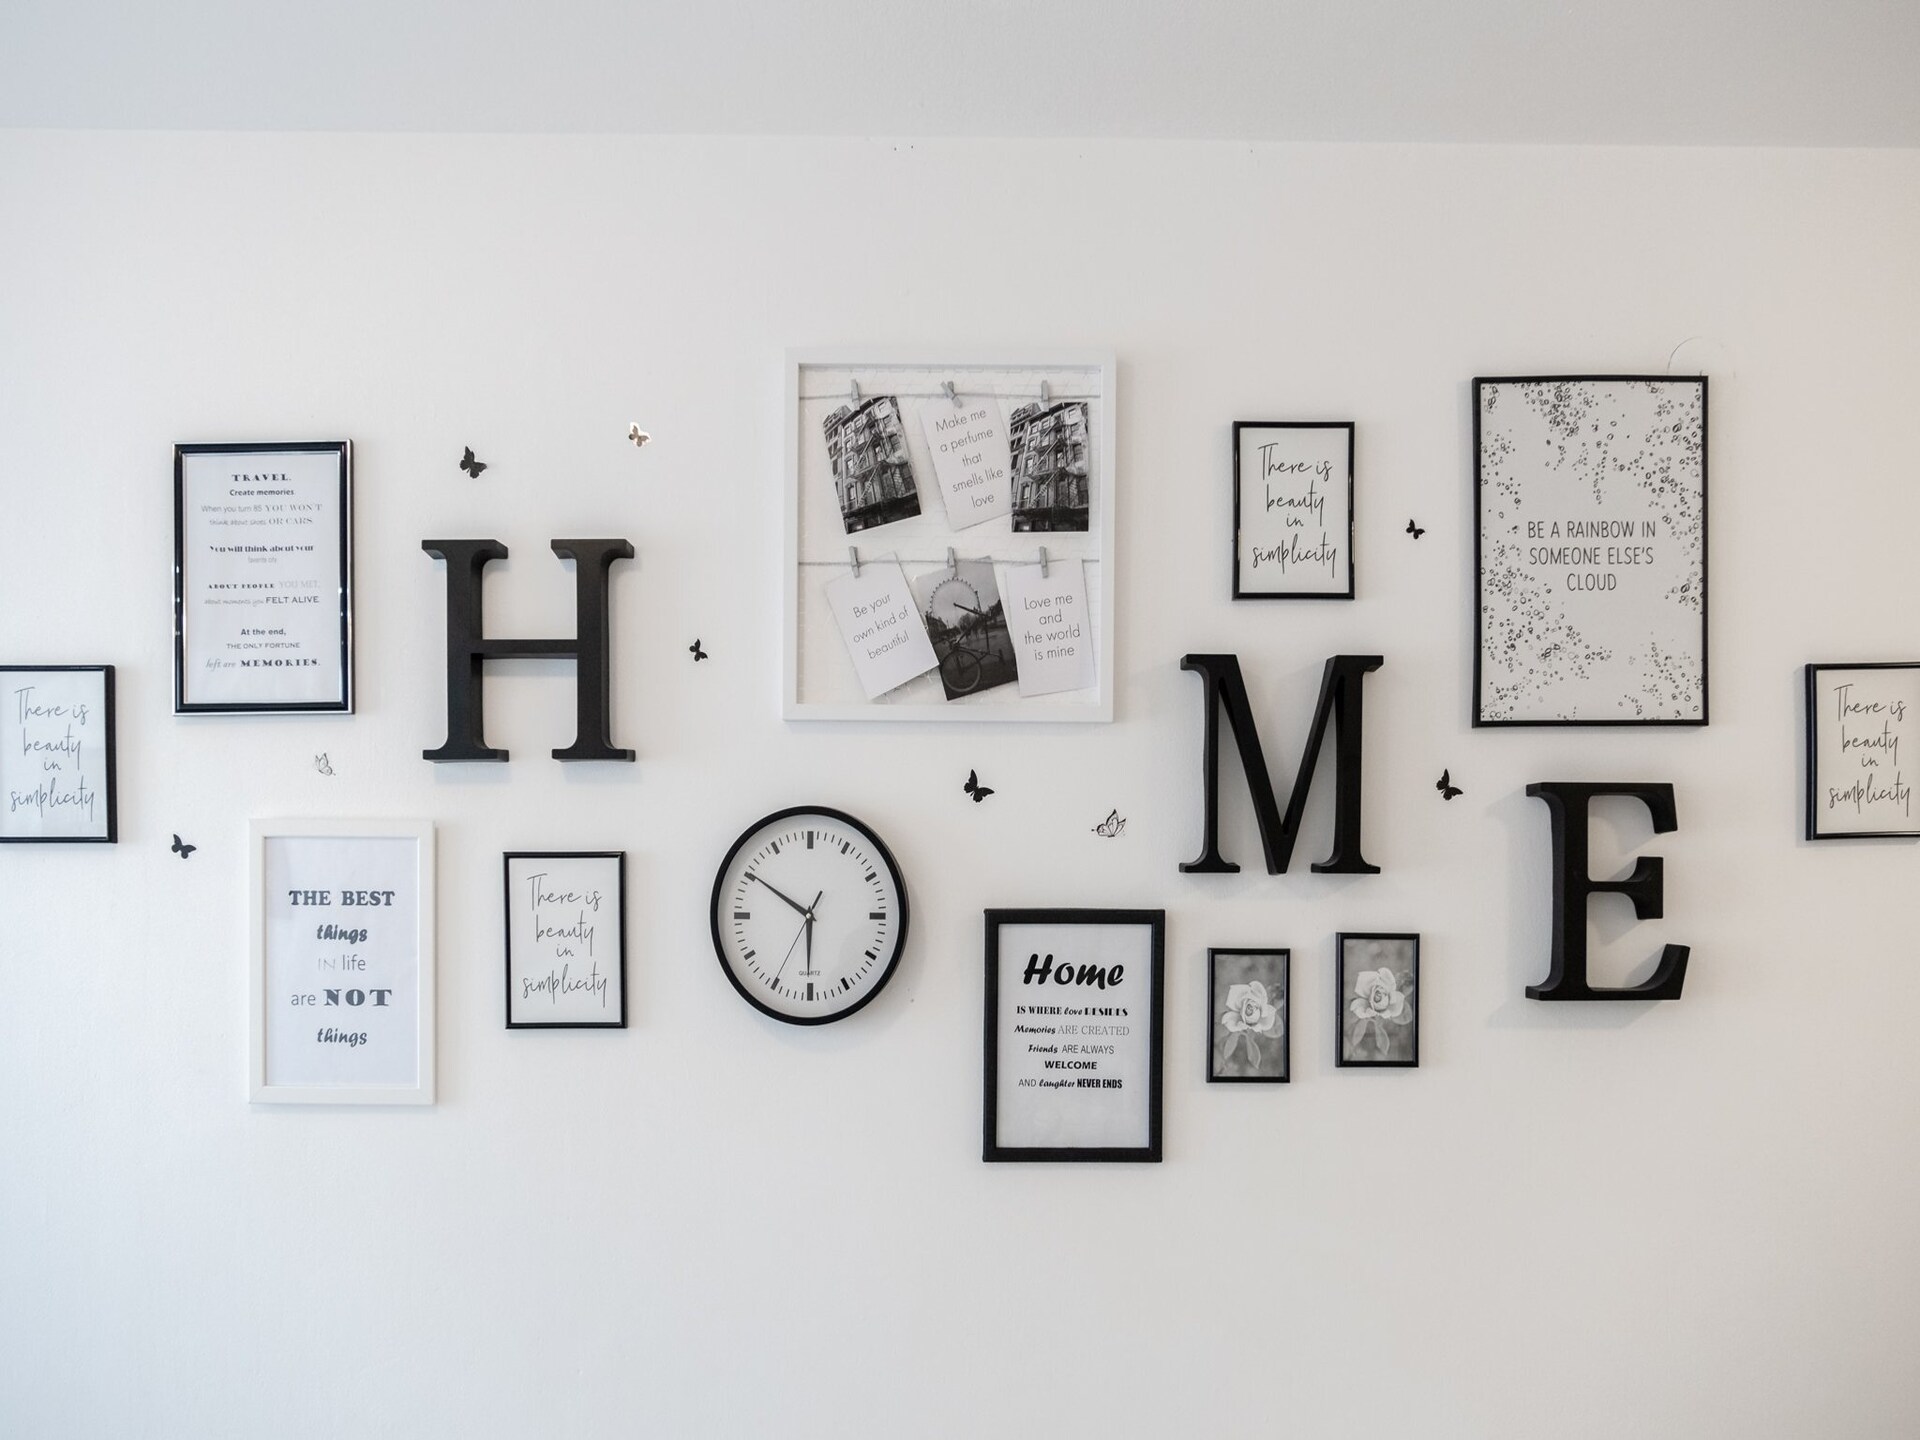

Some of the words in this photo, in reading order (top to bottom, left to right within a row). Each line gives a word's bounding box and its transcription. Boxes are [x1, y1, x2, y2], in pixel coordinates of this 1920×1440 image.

[936, 414, 967, 432] Make
[970, 409, 987, 421] me
[940, 443, 948, 453] a
[950, 429, 994, 453] perfume
[962, 453, 983, 467] that
[1258, 442, 1313, 480] There
[1315, 460, 1333, 482] is
[231, 474, 292, 482] TRAVEL.
[952, 473, 984, 493] smells
[985, 467, 1004, 481] like
[265, 504, 286, 512] YOU
[971, 494, 995, 508] love
[1266, 479, 1325, 527] beauty
[1286, 513, 1304, 527] in
[1528, 521, 1545, 538] BE
[1550, 521, 1560, 538] A
[1567, 520, 1634, 538] RAINBOW
[1642, 521, 1656, 538] IN
[210, 545, 226, 553] You
[227, 545, 243, 553] will
[1252, 531, 1337, 579] simplicity
[1529, 546, 1601, 565] SOMEONE
[1608, 546, 1654, 565] ELSE'S
[1566, 573, 1617, 591] CLOUD
[853, 606, 868, 618] Be
[869, 594, 891, 613] your
[1024, 597, 1051, 610] Love
[1055, 595, 1073, 606] me
[853, 627, 875, 643] own
[875, 612, 897, 632] kind
[898, 605, 909, 620] of
[1039, 609, 1063, 625] and
[1024, 630, 1043, 645] the
[1046, 623, 1081, 641] world
[867, 630, 910, 659] beautiful
[1034, 649, 1044, 661] is
[1046, 646, 1075, 659] mine
[205, 658, 221, 672] left
[240, 659, 321, 667] MEMORIES.
[14, 686, 70, 724] There
[72, 704, 90, 726] is
[1833, 683, 1887, 722] There
[1890, 700, 1907, 722] is
[23, 723, 81, 771] beauty
[1842, 719, 1898, 766] beauty
[44, 757, 62, 771] in
[1861, 753, 1879, 767] in
[10, 775, 95, 822] simplicity
[1829, 770, 1910, 817] simplicity
[289, 890, 331, 906] THE
[341, 890, 396, 906] BEST
[526, 873, 582, 911] There
[585, 890, 602, 912] is
[316, 924, 368, 944] things
[535, 909, 594, 957] beauty
[556, 943, 574, 957] in
[318, 957, 336, 971] IN
[342, 954, 366, 971] life
[1023, 953, 1124, 990] Home
[522, 961, 607, 1008] simplicity
[291, 994, 316, 1006] are
[323, 989, 393, 1006] NOT
[1016, 1005, 1026, 1014] IS
[1028, 1006, 1062, 1015] WHERE
[1064, 1006, 1083, 1016] love
[317, 1028, 368, 1047] things
[1014, 1025, 1056, 1035] Memories
[1057, 1025, 1078, 1035] ARE
[1081, 1025, 1130, 1036] CREATED
[1028, 1044, 1058, 1054] Friends
[1061, 1044, 1079, 1054] ARE
[1080, 1045, 1115, 1055] ALWAYS
[1044, 1060, 1098, 1070] WELCOME
[1018, 1078, 1037, 1087] AND
[1038, 1078, 1075, 1089] laughter
[1077, 1078, 1101, 1088] NEVER
[1102, 1079, 1123, 1089] ENDS
